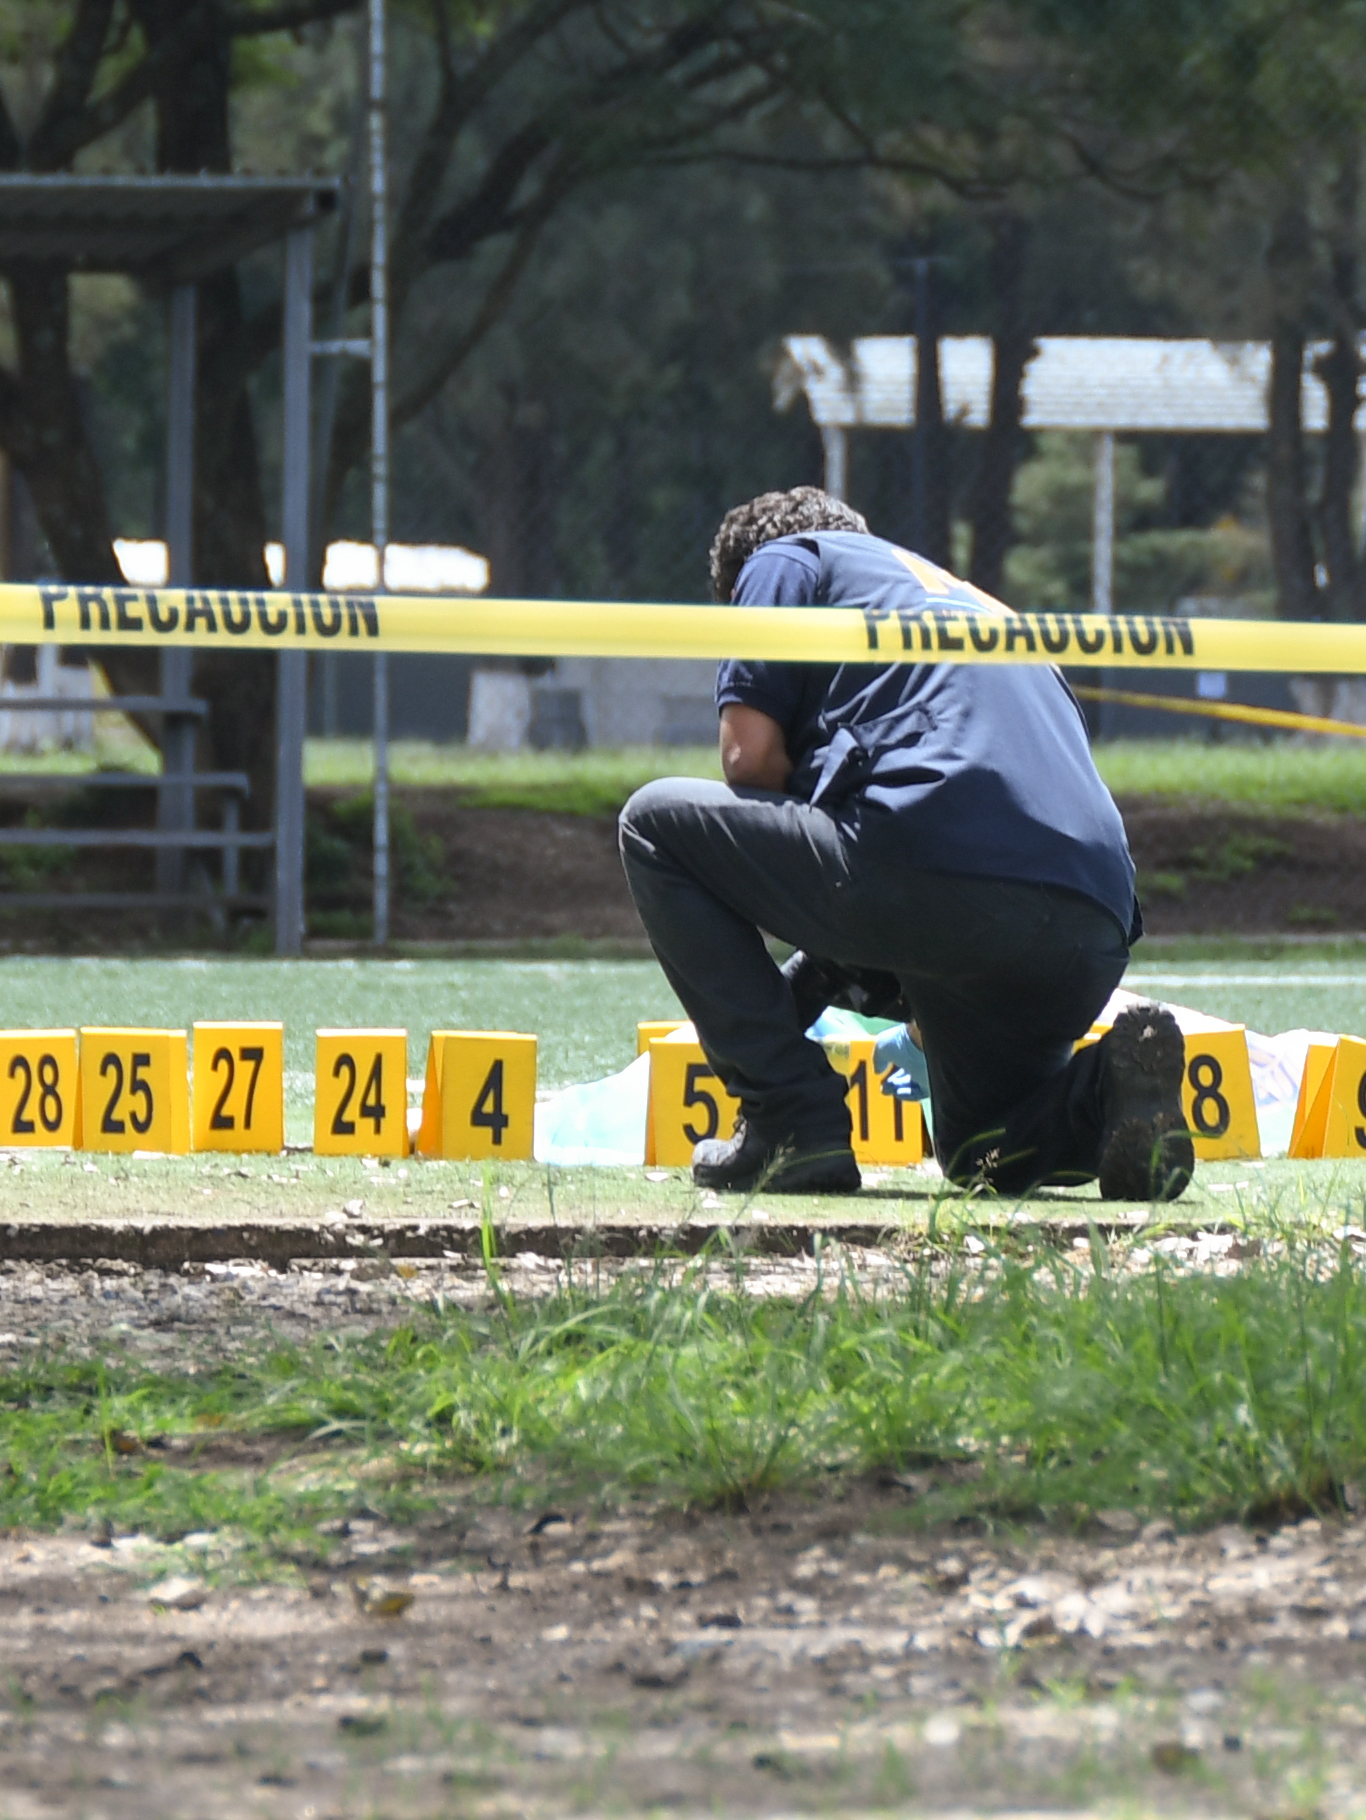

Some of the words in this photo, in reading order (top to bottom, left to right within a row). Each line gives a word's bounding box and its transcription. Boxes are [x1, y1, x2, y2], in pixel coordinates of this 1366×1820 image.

[10, 1055, 63, 1133] 28
[100, 1052, 154, 1134] 25
[211, 1047, 264, 1130] 27
[332, 1053, 386, 1135] 24
[470, 1059, 509, 1146] 4
[682, 1062, 719, 1145] 5
[1188, 1054, 1231, 1135] 8
